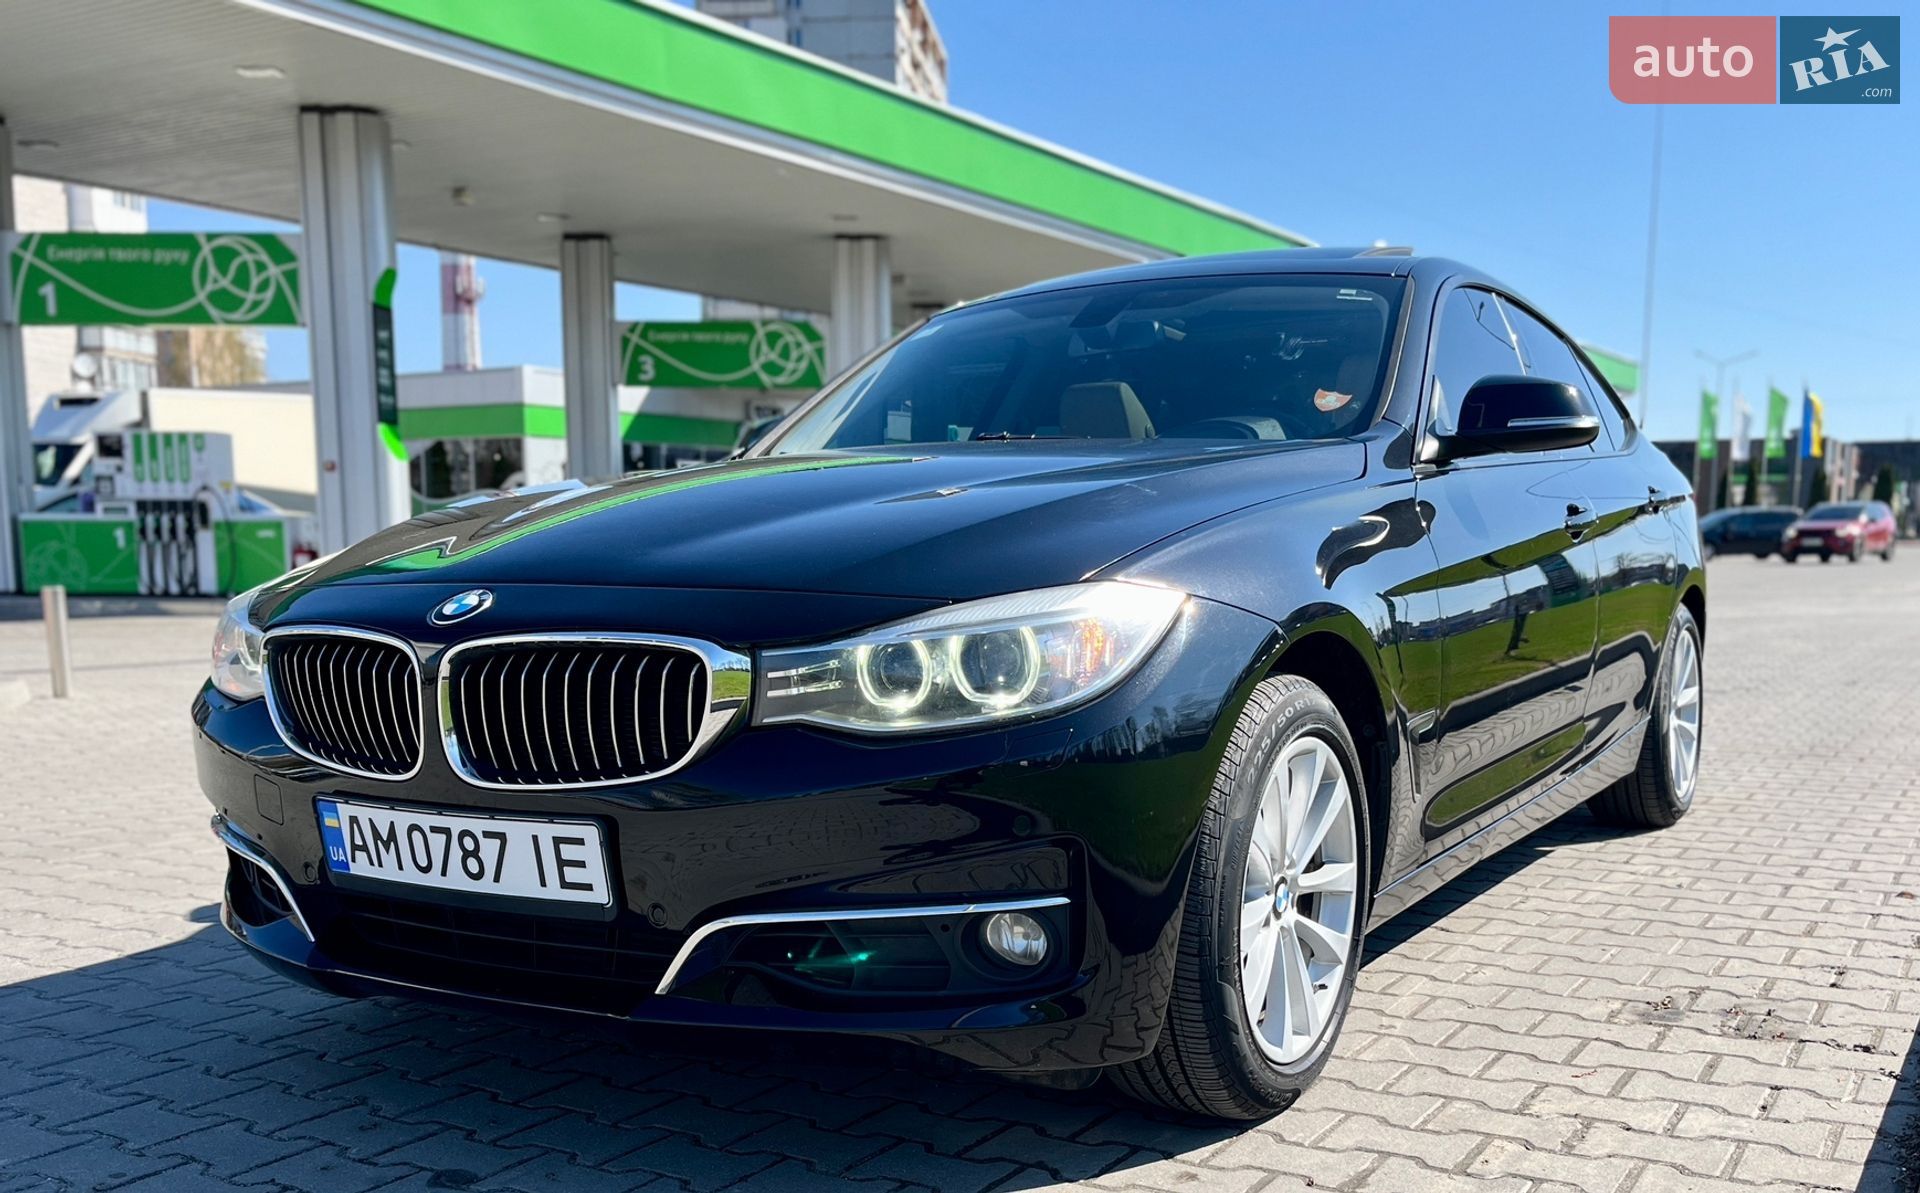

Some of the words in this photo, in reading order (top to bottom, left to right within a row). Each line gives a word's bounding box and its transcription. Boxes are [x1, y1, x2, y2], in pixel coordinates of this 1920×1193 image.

[38, 281, 57, 317] 1
[637, 355, 655, 381] 3
[114, 527, 126, 549] 1
[329, 846, 347, 863] UA
[349, 815, 507, 883] AM0787
[531, 834, 594, 892] IE
